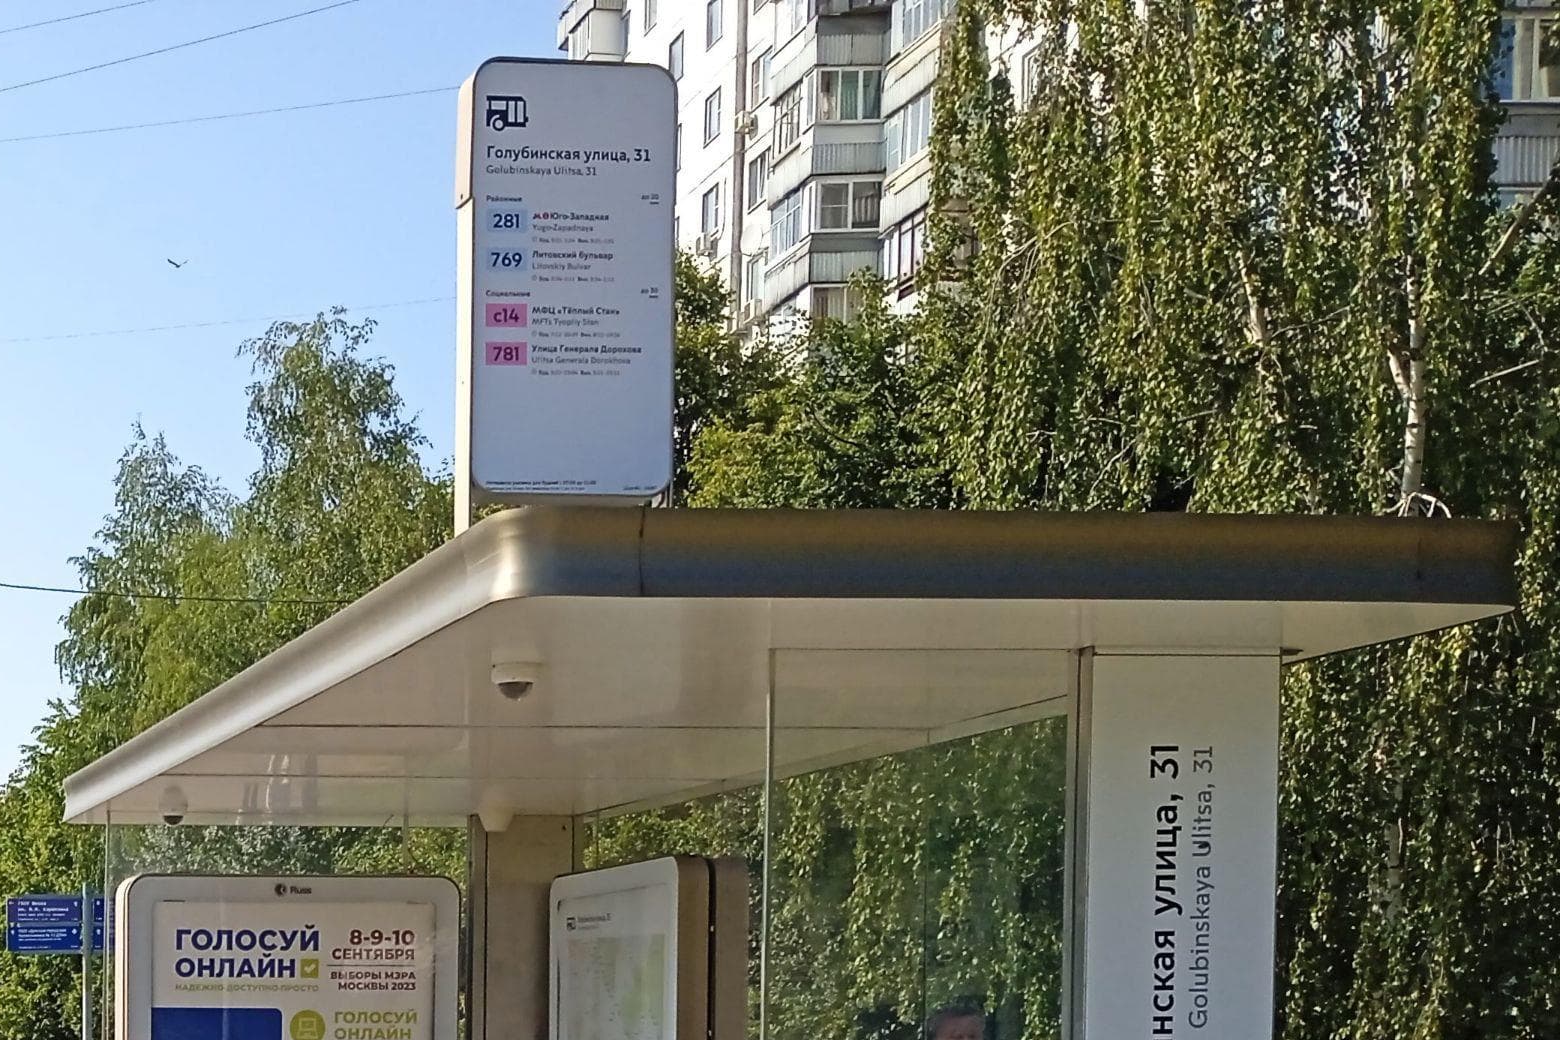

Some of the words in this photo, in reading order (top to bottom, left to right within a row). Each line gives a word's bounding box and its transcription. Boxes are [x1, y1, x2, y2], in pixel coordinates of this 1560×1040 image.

[486, 146, 580, 163] Голубинская
[584, 149, 630, 163] улица,
[633, 149, 651, 162] 31
[486, 165, 552, 177] Golubinskaya
[586, 167, 597, 176] 31
[493, 214, 520, 229] 281
[551, 212, 609, 221] Юго-Западная
[491, 252, 523, 267] 769
[532, 250, 577, 258] Литовский
[579, 251, 614, 260] бульвар
[531, 307, 556, 315] МФЦ
[493, 346, 520, 361] 781
[531, 345, 557, 353] Улица
[559, 344, 598, 354] Генерала
[600, 345, 642, 354] Дорохова
[1150, 746, 1179, 779] 31
[1193, 746, 1213, 773] 31
[1191, 784, 1216, 857] Ulitsa,
[1154, 794, 1184, 916] улица,
[290, 886, 312, 894] Russ
[176, 924, 319, 951] ГОЛОСУЙ
[349, 929, 415, 945] 8-9-10
[332, 948, 415, 960] СЕНТЯБРЯ
[1188, 866, 1215, 1029] Golubinskaya
[175, 952, 296, 978] ОНЛАЙН
[330, 971, 381, 979] ВЫБОРЫ
[385, 971, 416, 980] МЭРА
[338, 982, 388, 990] МОСКВЫ
[391, 982, 416, 991] 2023
[334, 1009, 417, 1024] ГОЛОСУЙ
[334, 1025, 411, 1040] ОНЛАЙН
